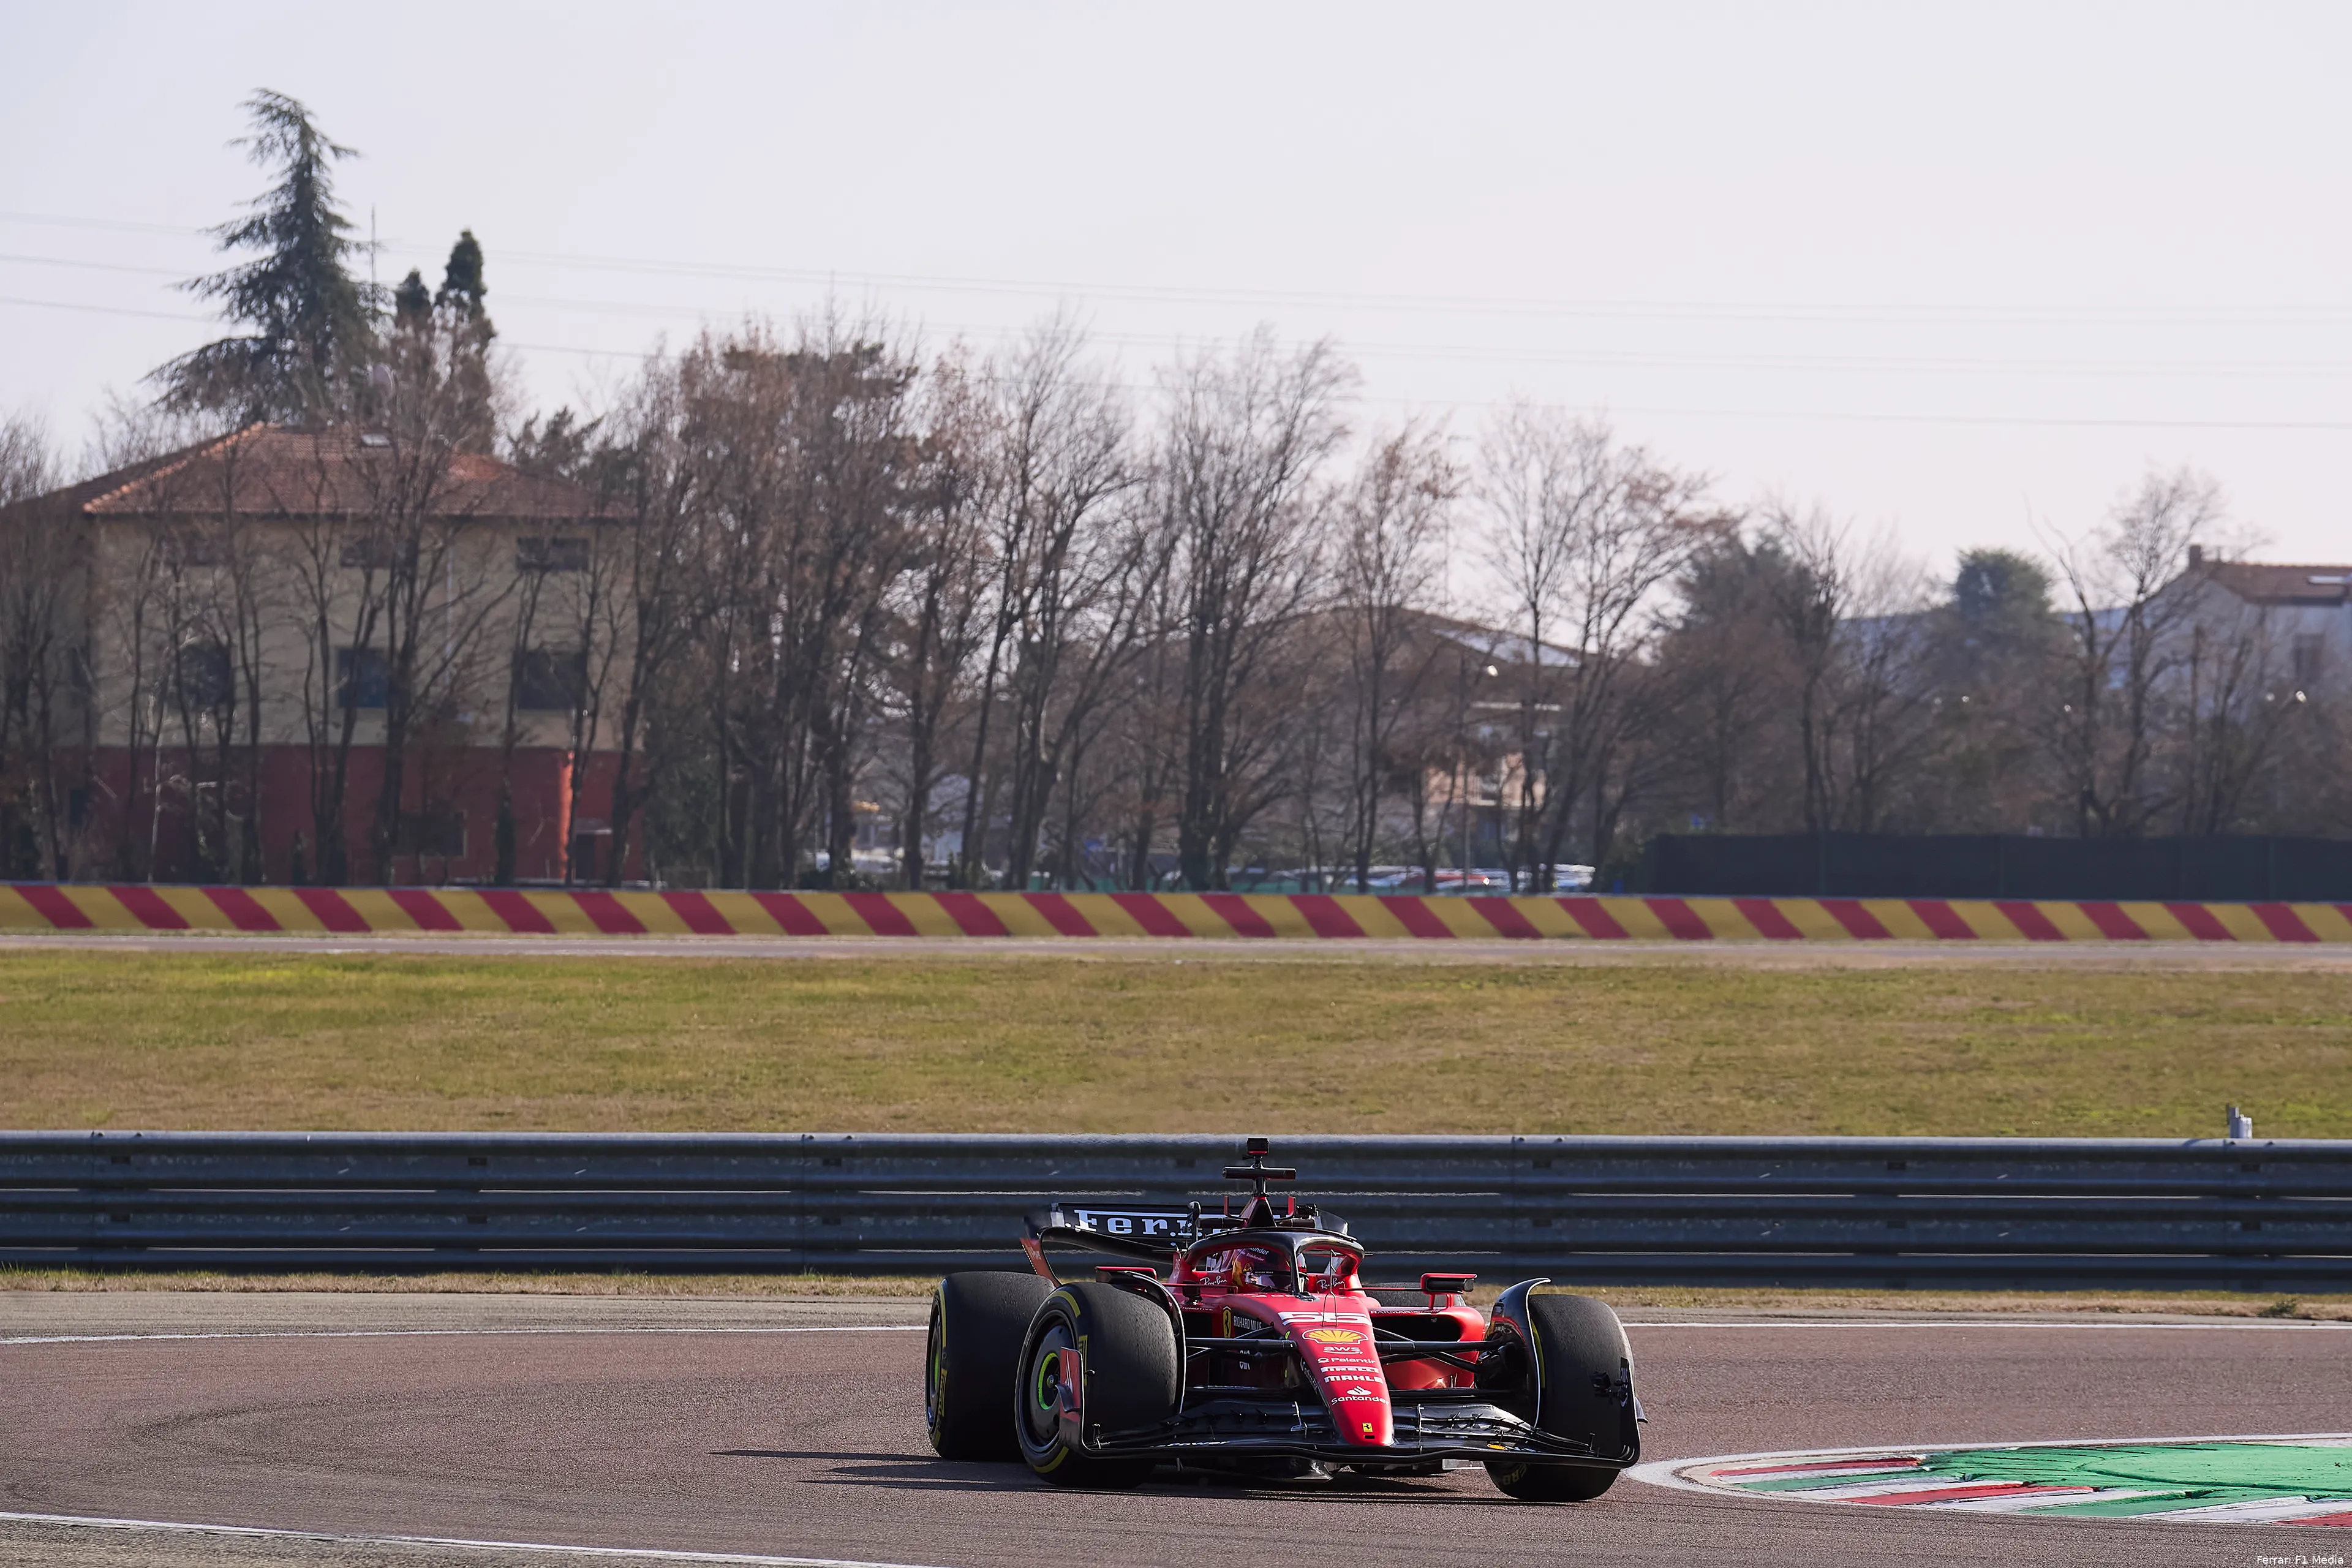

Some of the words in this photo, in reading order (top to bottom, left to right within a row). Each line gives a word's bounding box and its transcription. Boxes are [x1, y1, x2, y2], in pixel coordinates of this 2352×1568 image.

[1234, 1316, 1250, 1329] RICHARD
[1278, 1311, 1373, 1326] 55
[1324, 1374, 1384, 1384] MAHLE
[1331, 1395, 1390, 1406] Santander
